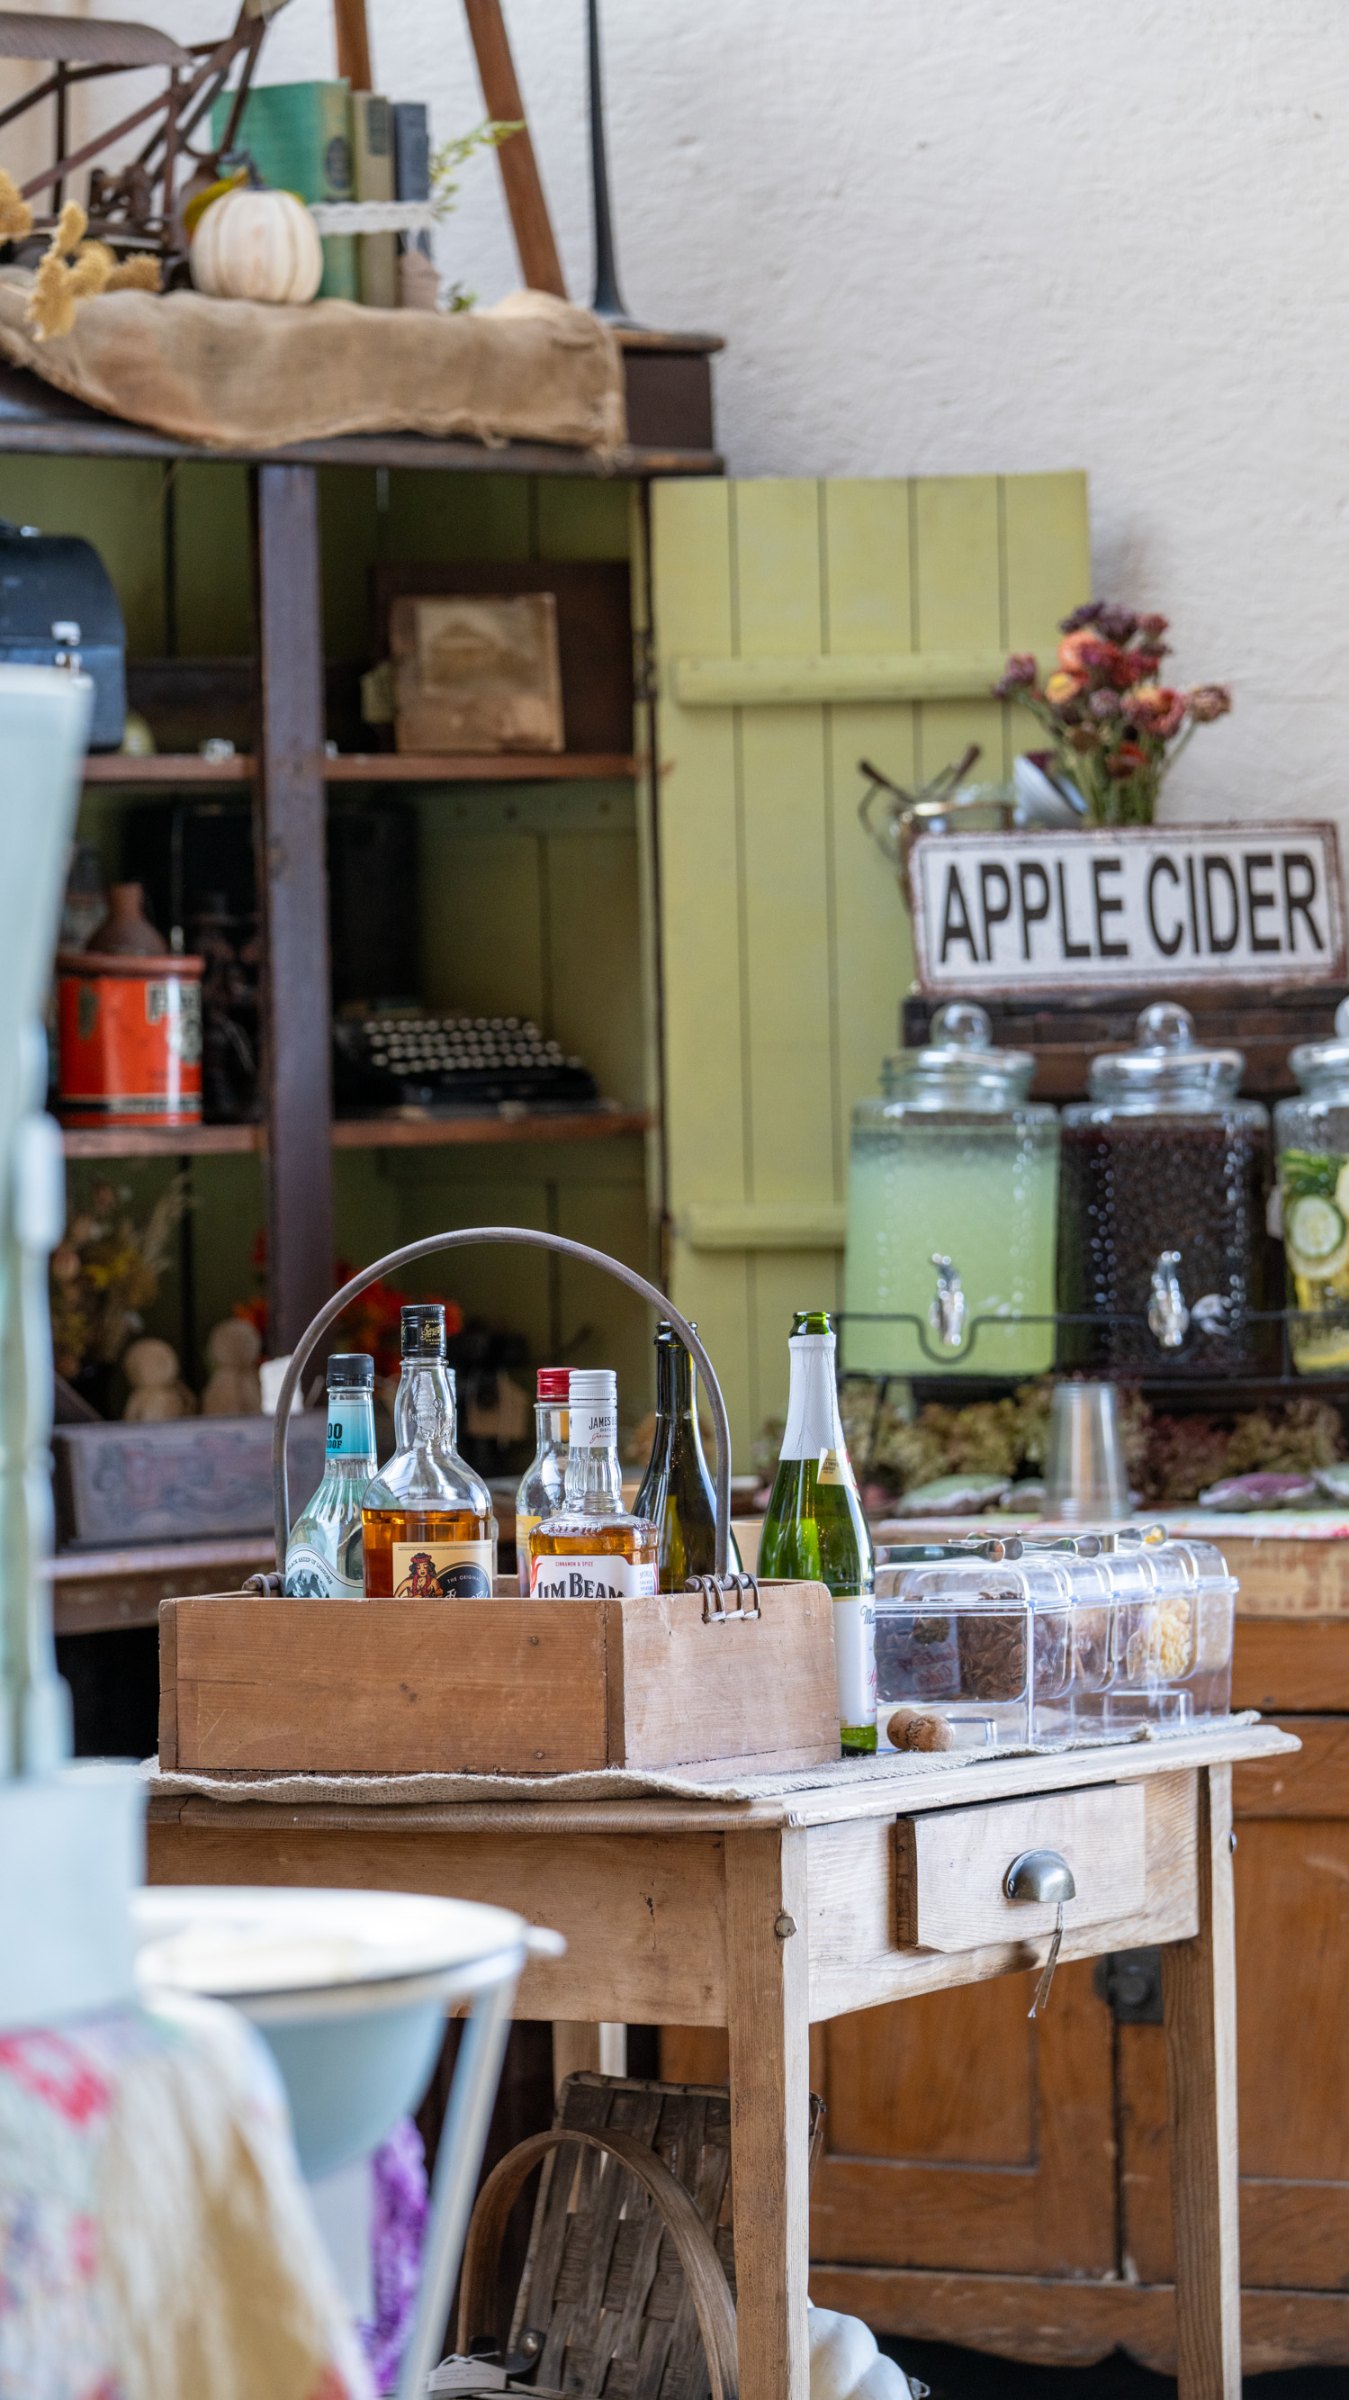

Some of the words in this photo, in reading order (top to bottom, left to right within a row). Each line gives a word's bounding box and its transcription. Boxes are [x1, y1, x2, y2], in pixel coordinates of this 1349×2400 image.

[940, 857, 1129, 963] APPLE
[1147, 853, 1325, 957] CIDER
[327, 1422, 343, 1440] 00
[588, 1416, 611, 1431] JAMES
[447, 1576, 457, 1584] THE
[537, 1580, 566, 1598] JIM
